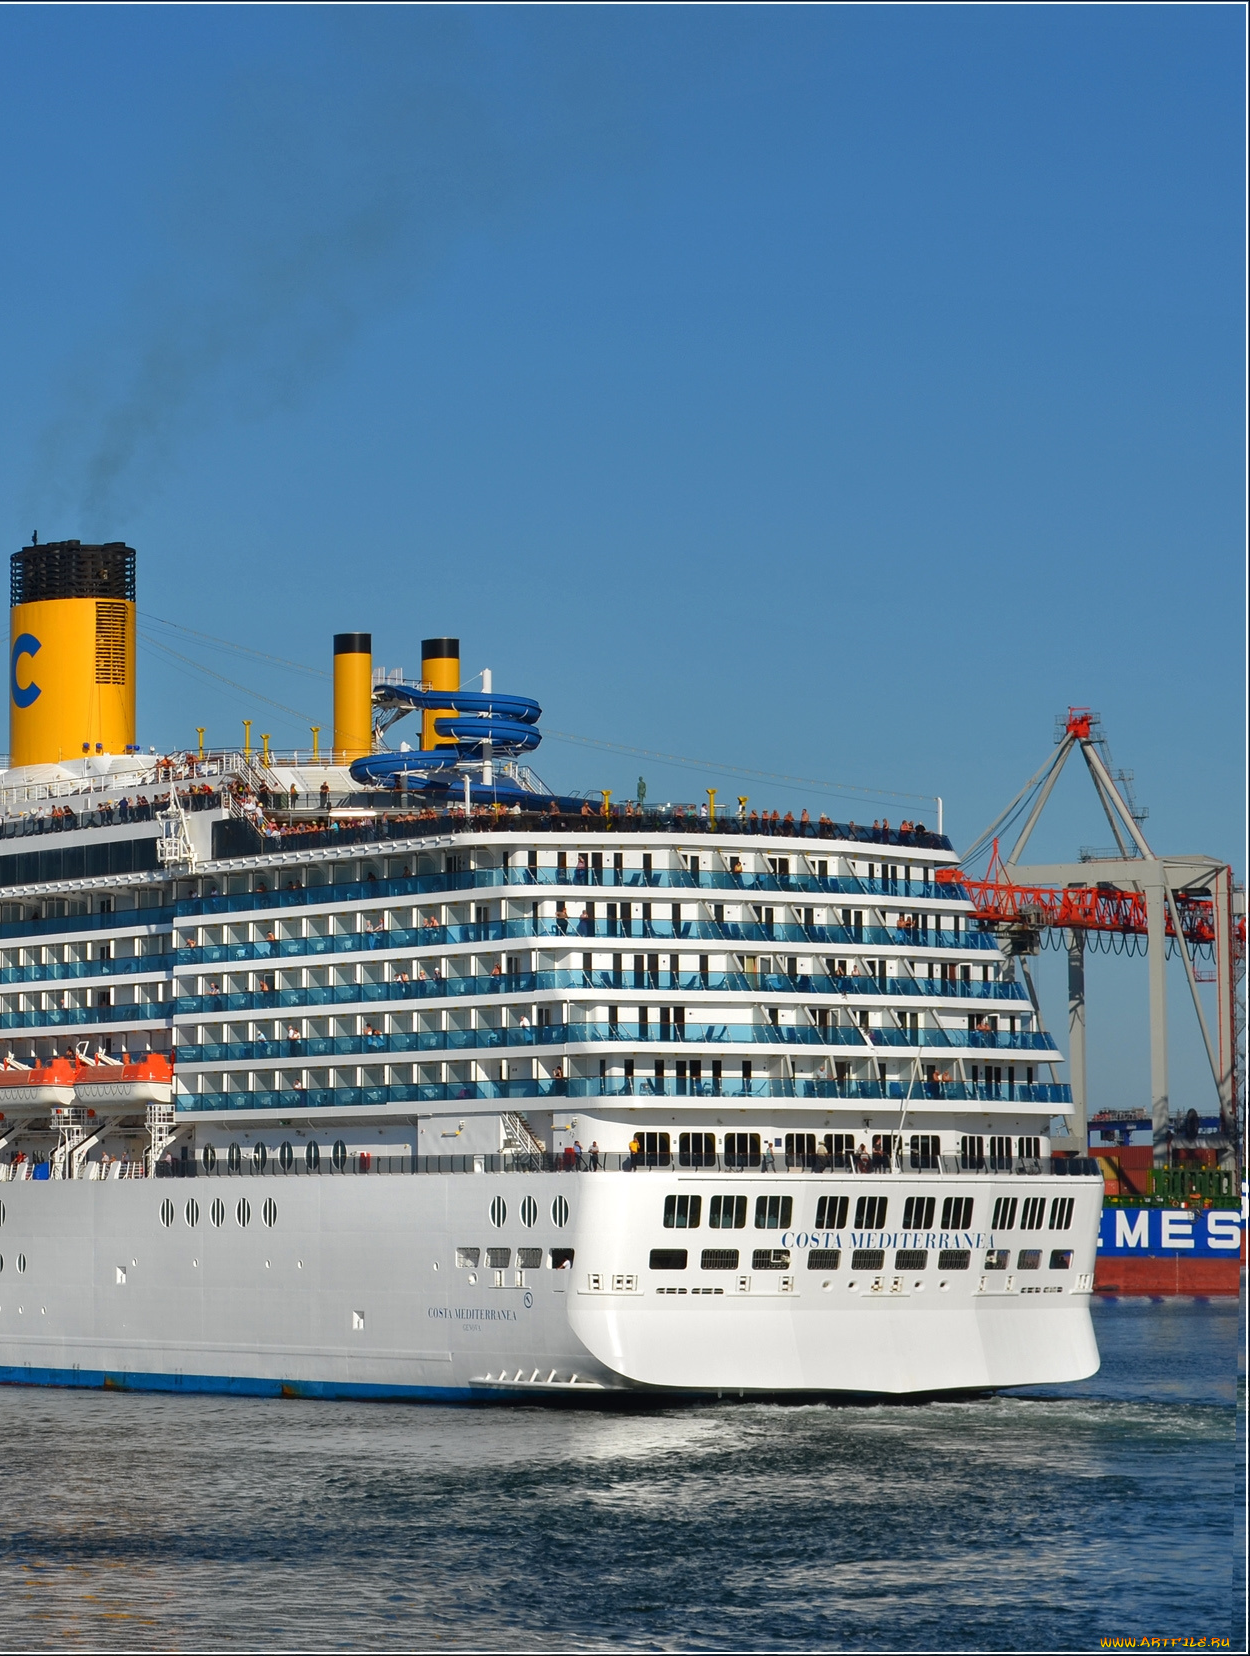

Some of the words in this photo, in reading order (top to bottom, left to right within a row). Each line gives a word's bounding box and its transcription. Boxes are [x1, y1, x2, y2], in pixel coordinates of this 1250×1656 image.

[11, 633, 42, 708] C
[781, 1232, 842, 1248] COSTA
[849, 1233, 995, 1248] MEDITERRANEA
[1097, 1210, 1241, 1249] MES
[427, 1307, 452, 1319] COSTA
[454, 1308, 517, 1320] MEDITERRANEA
